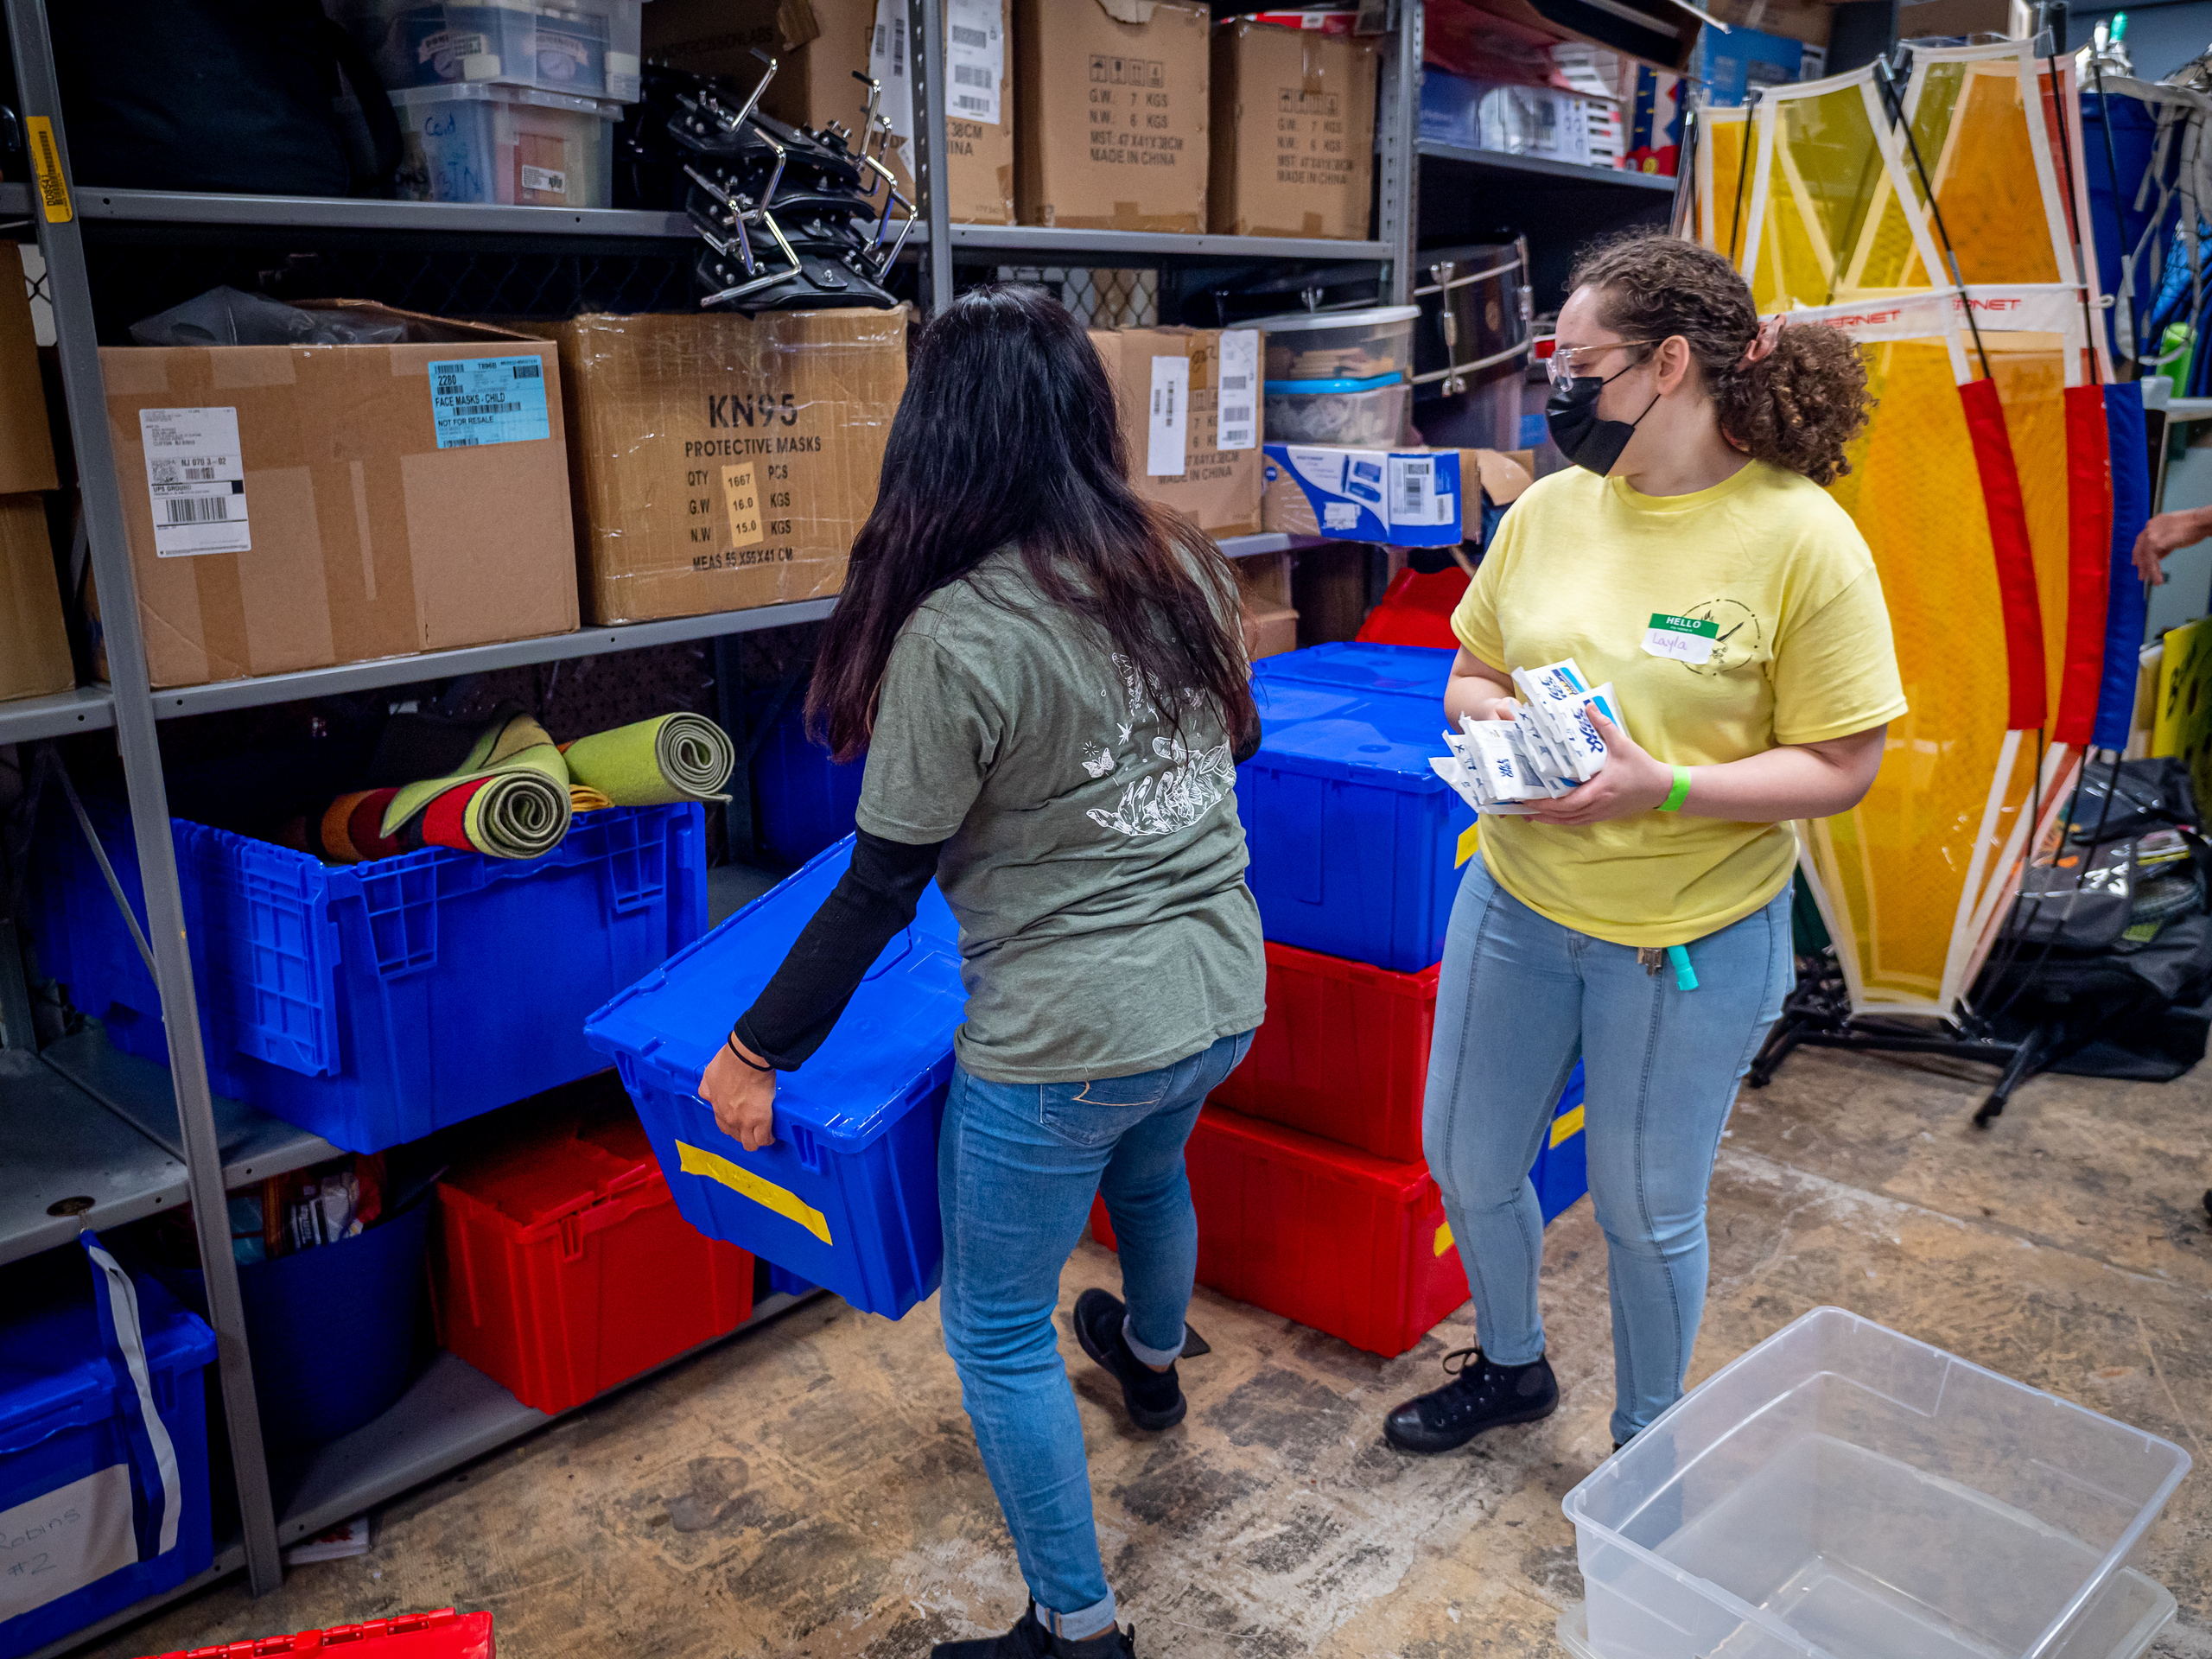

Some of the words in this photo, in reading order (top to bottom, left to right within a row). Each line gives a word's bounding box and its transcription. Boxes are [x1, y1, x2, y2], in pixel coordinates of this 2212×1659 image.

[1131, 92, 1137, 105] 7
[1146, 92, 1167, 107] KGS
[1146, 114, 1167, 129] KGS
[1090, 148, 1124, 163] MADE
[1127, 150, 1139, 164] IN
[1141, 150, 1176, 166] CHINA
[437, 374, 457, 385] 2280
[435, 397, 454, 407] FACE
[455, 395, 480, 405] MASKS
[485, 392, 505, 404] CHILD
[709, 393, 798, 429] KN95
[454, 417, 467, 426] FOR
[468, 416, 493, 425] RESALE
[685, 438, 772, 458] PROTECTIVE
[778, 435, 821, 454] MASKS
[688, 470, 709, 486] QTY
[728, 474, 751, 488] 1667
[768, 464, 788, 480] PCS
[1190, 469, 1200, 482] IN
[1203, 466, 1232, 480] CHINA
[690, 499, 709, 515] G.W
[733, 497, 753, 511] 16.0
[770, 492, 791, 508] KGS
[691, 527, 711, 543] N.W
[736, 520, 757, 534] 15.0
[771, 519, 791, 535] KGS
[693, 553, 722, 571] MEAS
[779, 547, 793, 562] CM
[1666, 616, 1701, 629] HELLO
[1652, 632, 1687, 652] Layla
[7, 1553, 57, 1575] #2
